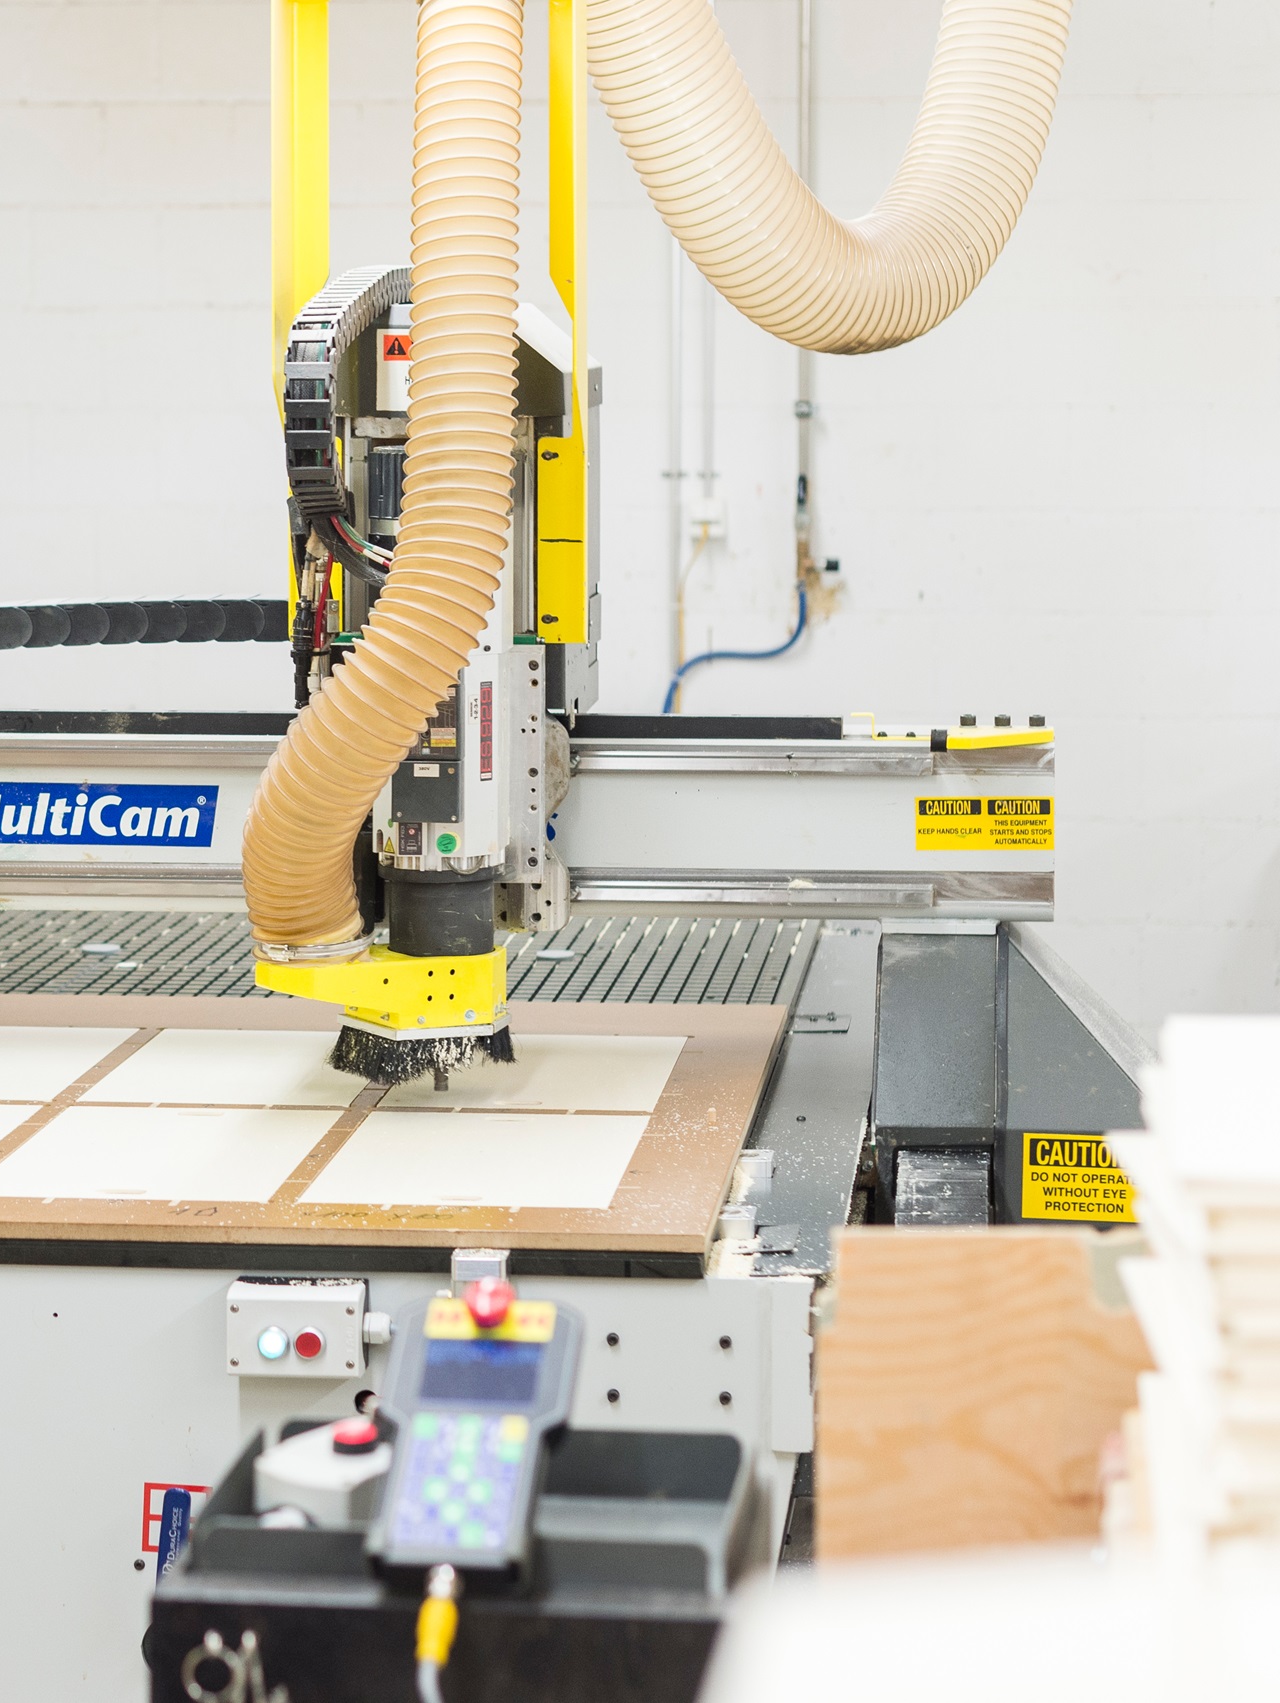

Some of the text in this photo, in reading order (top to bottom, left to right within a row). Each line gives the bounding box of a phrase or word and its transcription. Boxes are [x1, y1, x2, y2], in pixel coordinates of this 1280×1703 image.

[925, 800, 971, 815] CAUTION
[995, 800, 1040, 815] CAUTION
[1010, 819, 1047, 827] EQUIPMENT
[1031, 1172, 1049, 1182] DO
[1052, 1173, 1078, 1183] NOT
[1042, 1187, 1127, 1199] WITHOUT EYE
[1045, 1201, 1124, 1213] PROTECTION
